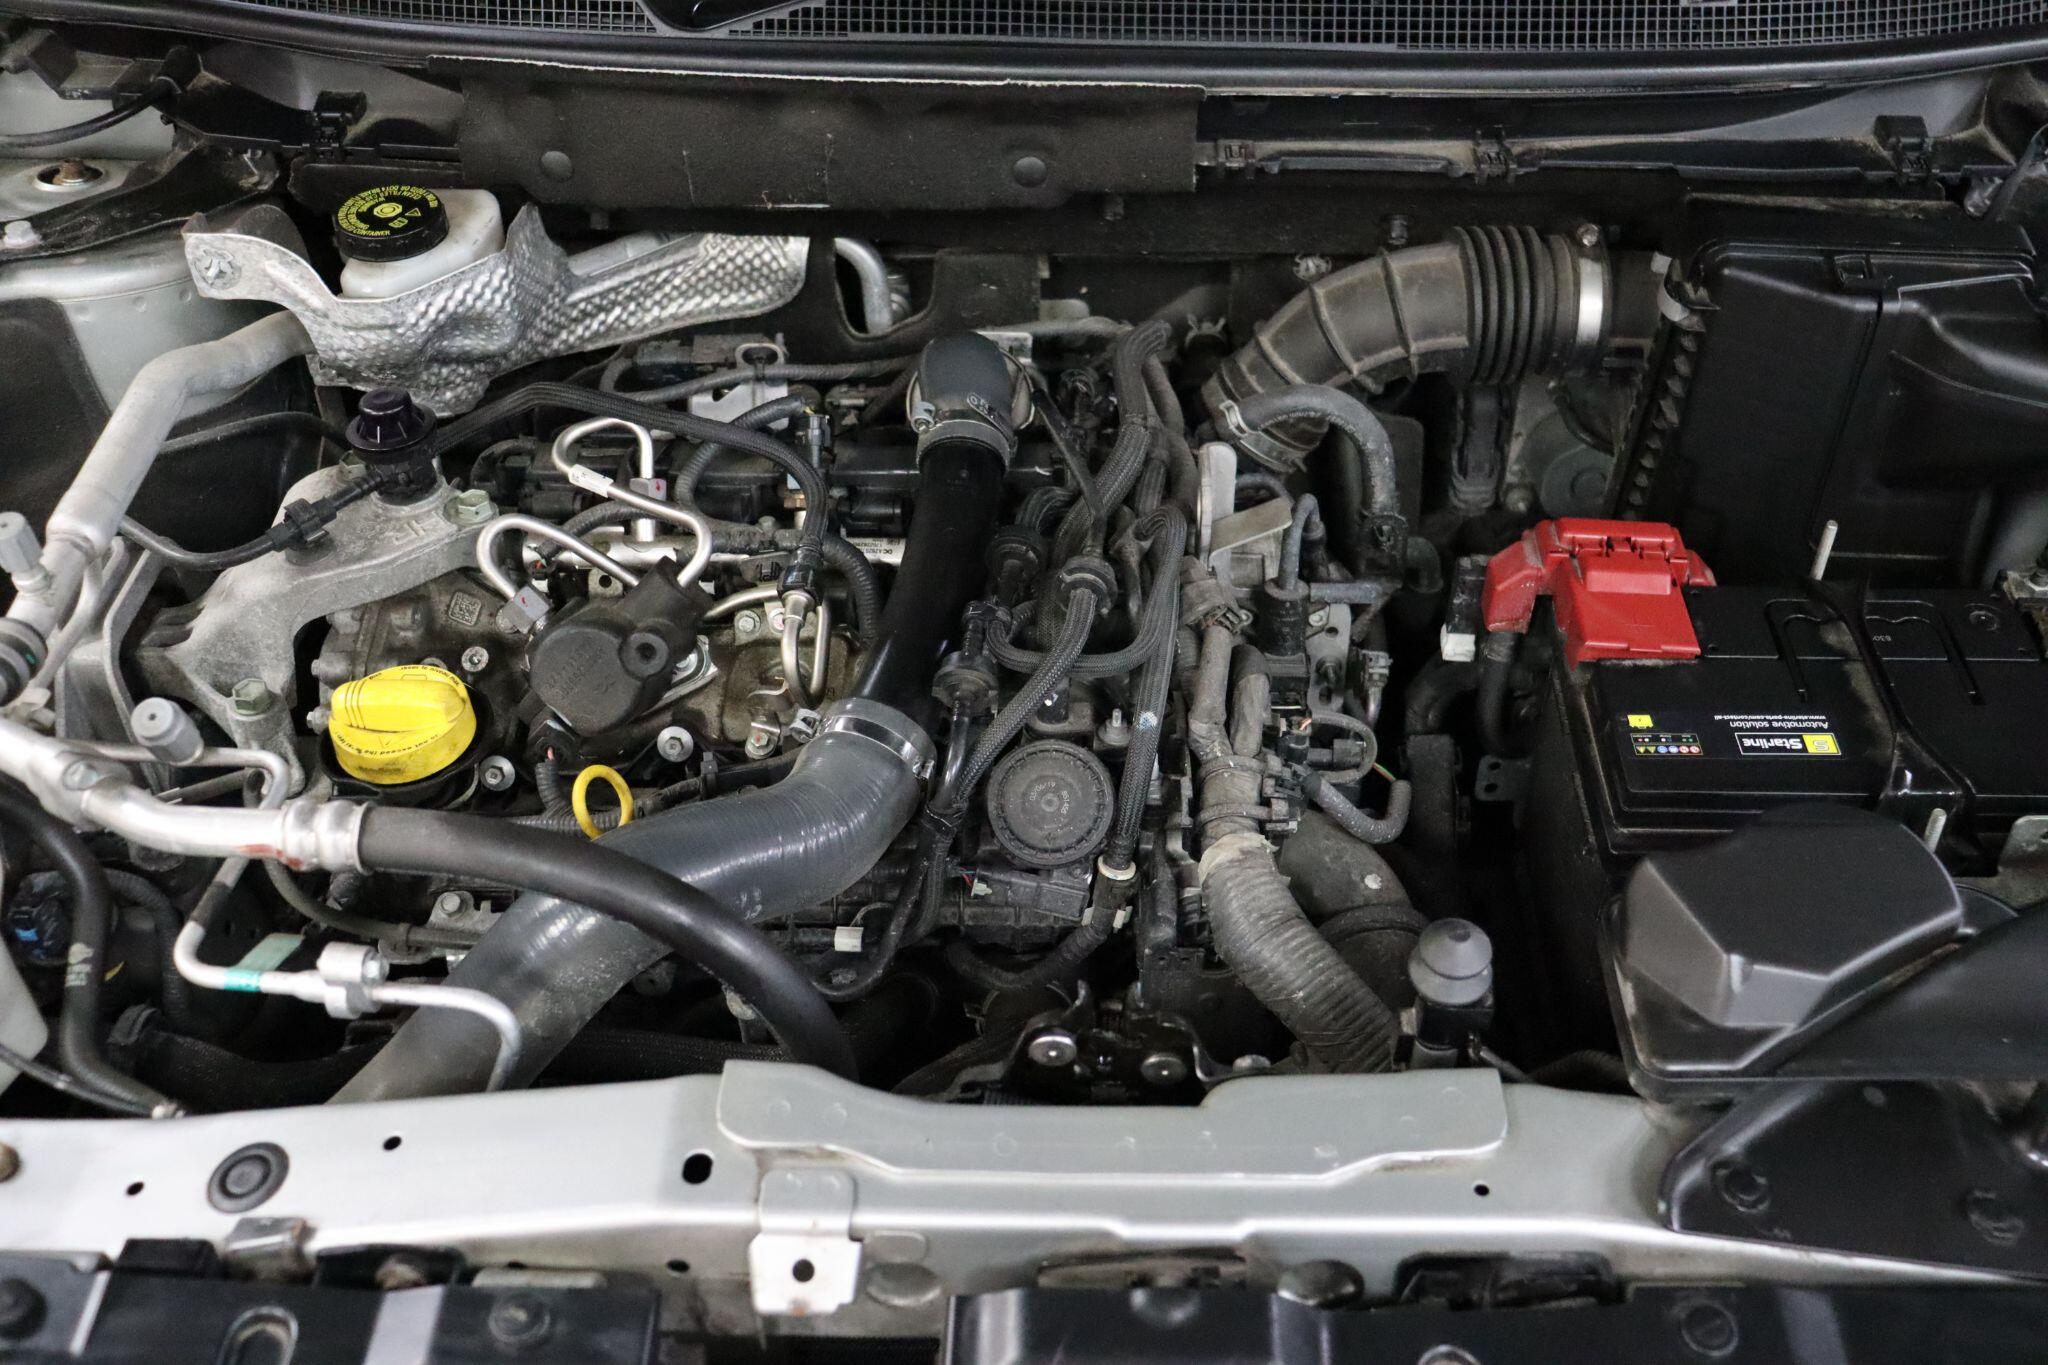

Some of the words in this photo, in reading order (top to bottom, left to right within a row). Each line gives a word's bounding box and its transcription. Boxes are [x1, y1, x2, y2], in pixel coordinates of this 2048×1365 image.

[1729, 721, 1770, 729] solution
[1772, 721, 1829, 729] Automotive
[1742, 738, 1803, 751] Starline
